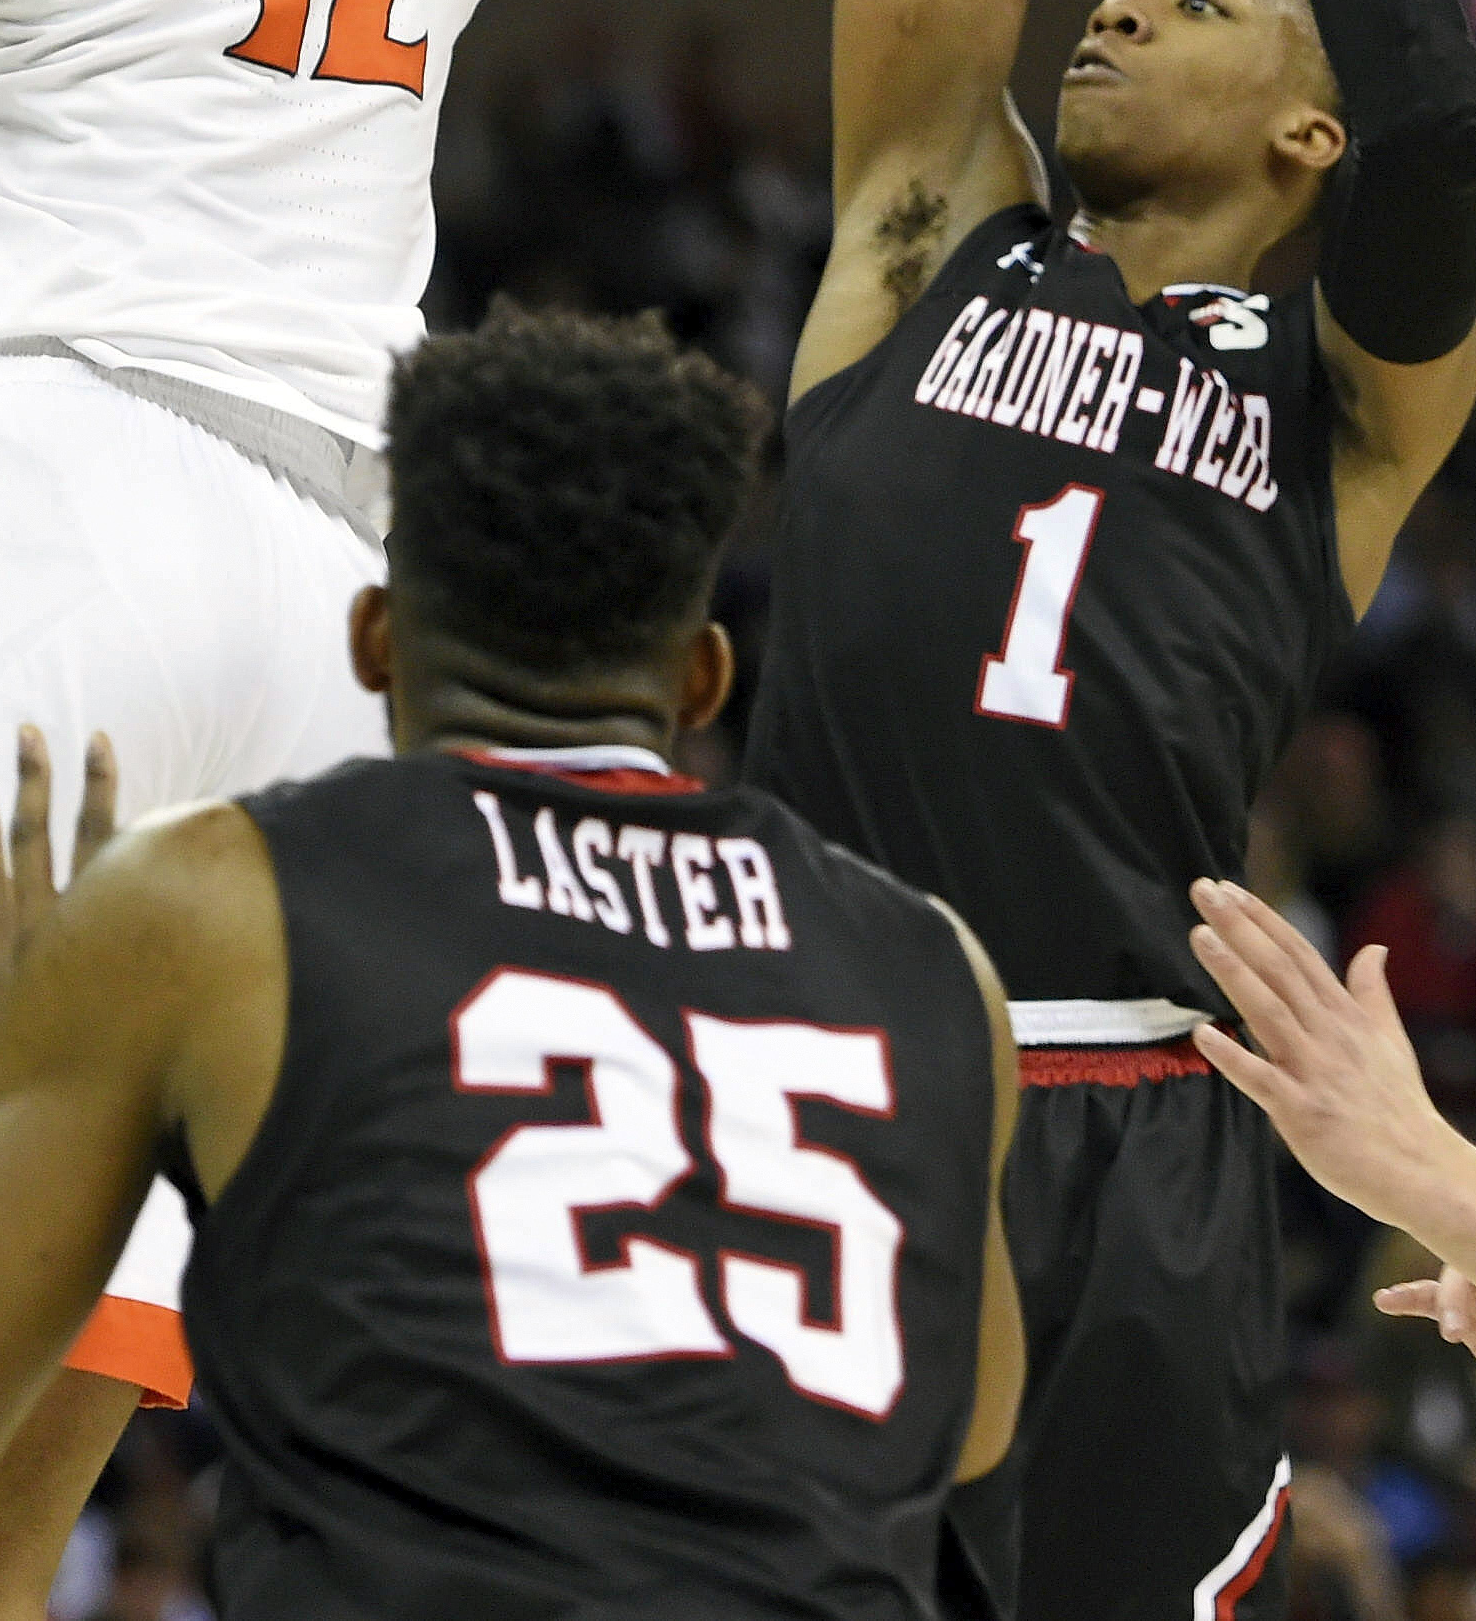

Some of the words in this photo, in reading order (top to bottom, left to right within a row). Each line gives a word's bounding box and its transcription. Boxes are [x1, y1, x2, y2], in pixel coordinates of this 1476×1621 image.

[972, 481, 1107, 731] 1
[473, 789, 793, 952] LASTER
[448, 962, 907, 1426] 25
